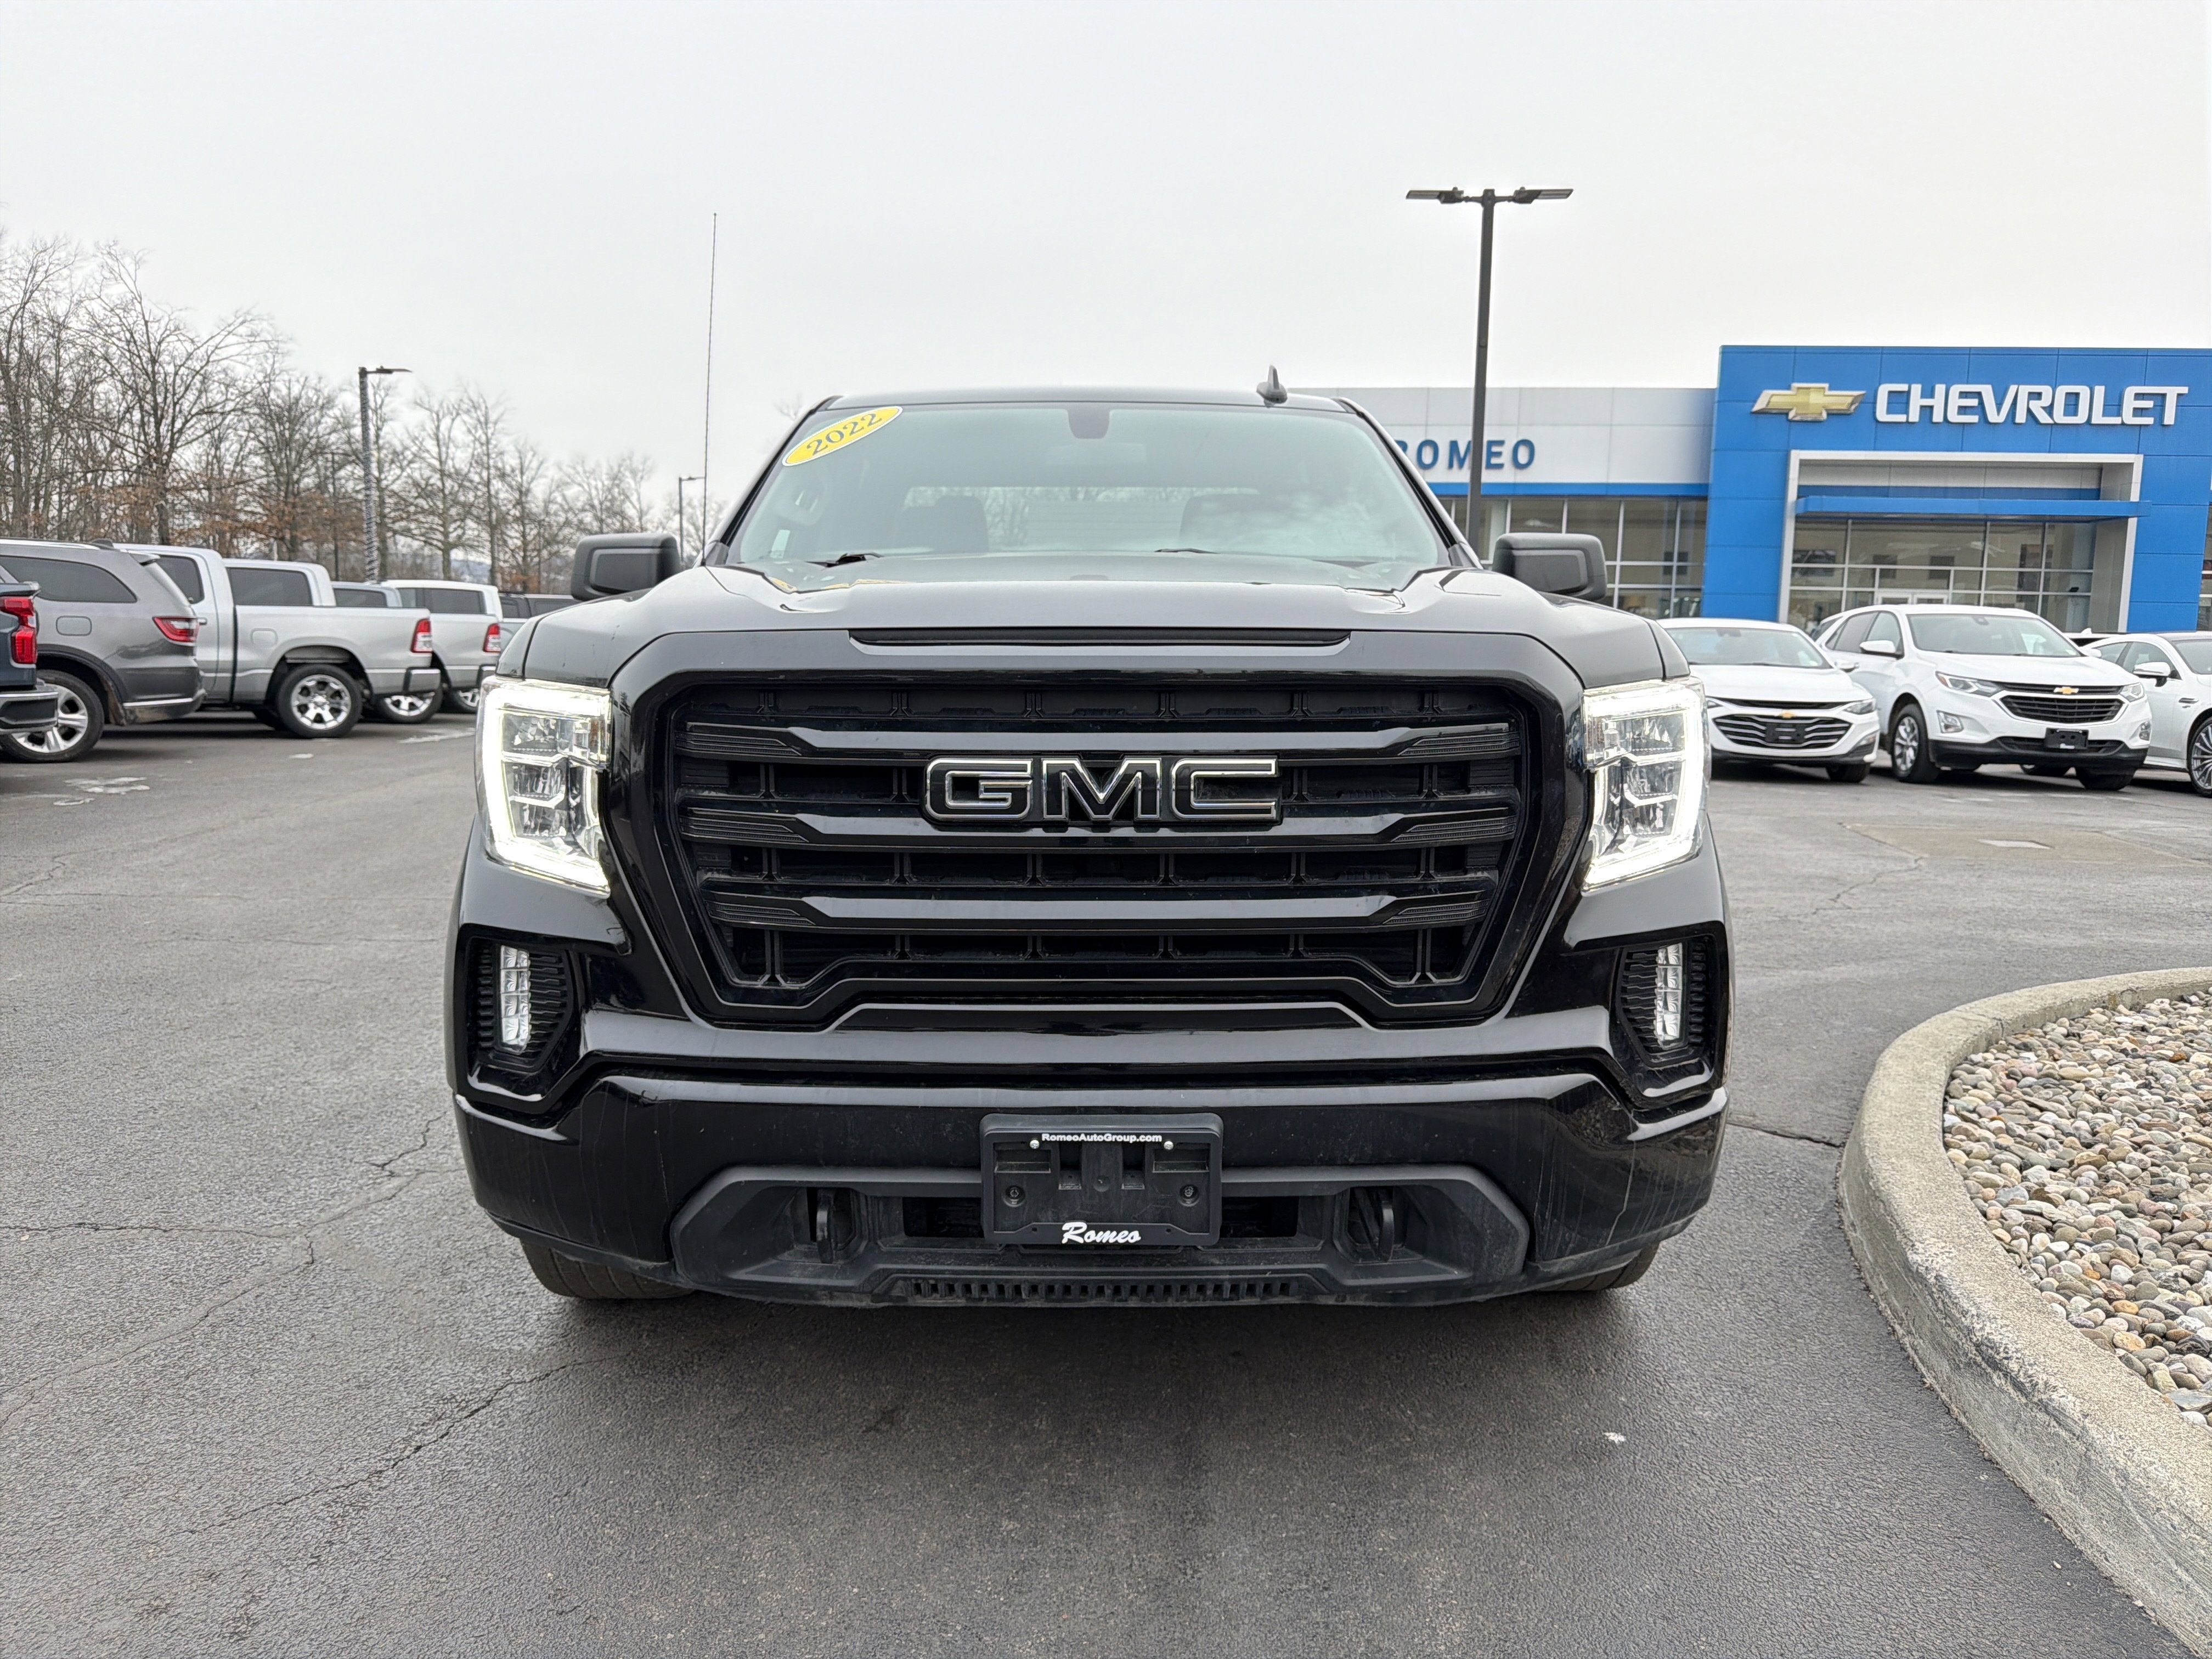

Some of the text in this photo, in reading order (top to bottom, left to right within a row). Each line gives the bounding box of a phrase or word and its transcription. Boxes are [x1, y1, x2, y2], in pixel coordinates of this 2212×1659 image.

[1875, 383, 2189, 425] CHEVROLET
[806, 413, 882, 456] 2022
[926, 757, 1279, 821] GMC
[1041, 1133, 1163, 1143] RomeoAutoGroup.com
[1061, 1221, 1142, 1244] Romeo
